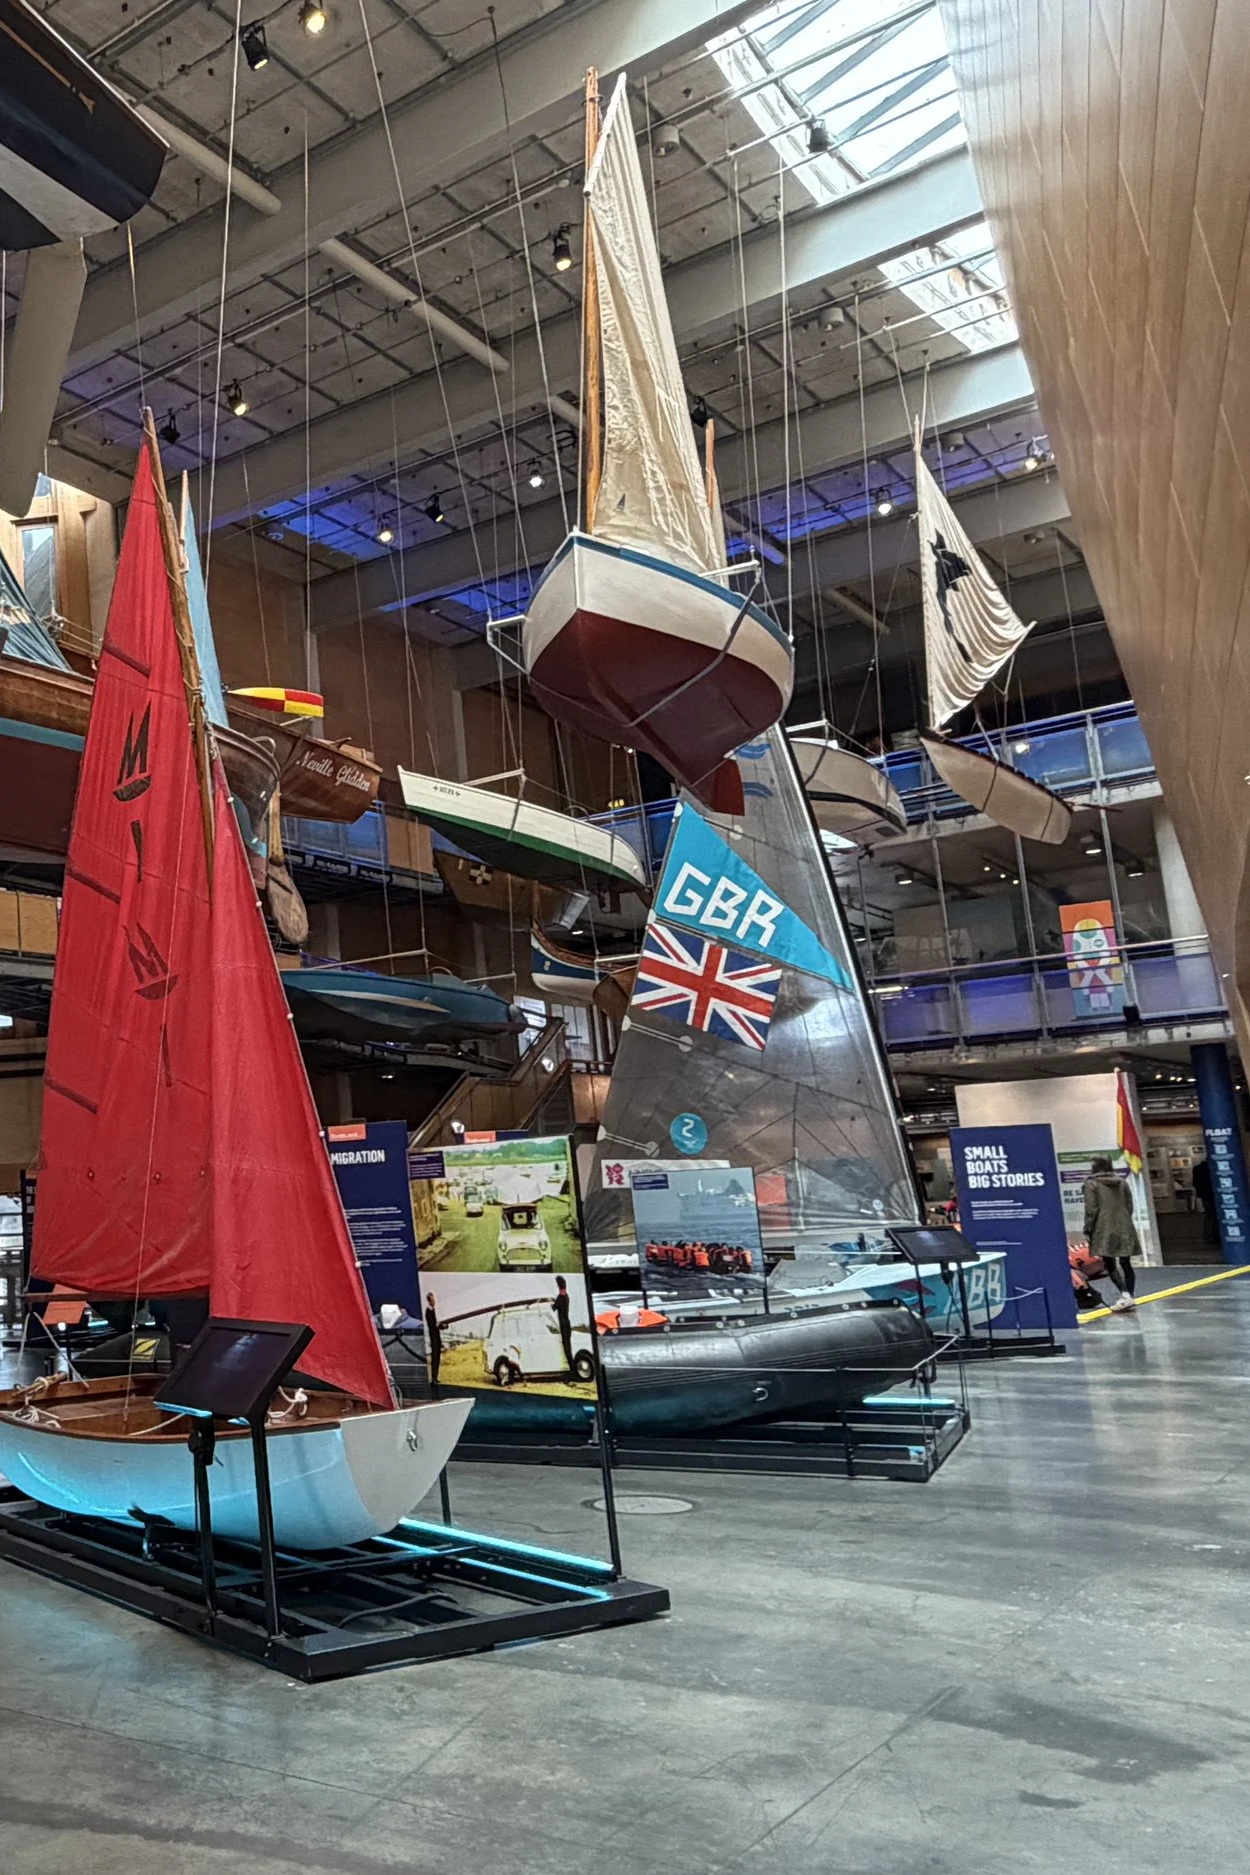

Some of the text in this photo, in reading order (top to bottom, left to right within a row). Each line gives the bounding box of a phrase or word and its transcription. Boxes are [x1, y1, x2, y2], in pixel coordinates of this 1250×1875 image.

[296, 750, 334, 777] Neville
[663, 862, 785, 948] GBR
[331, 1149, 385, 1165] MIGRATION
[964, 1146, 1008, 1160] SMALL
[966, 1160, 1008, 1174] BOATS
[968, 1173, 1045, 1189] BIG STORIES
